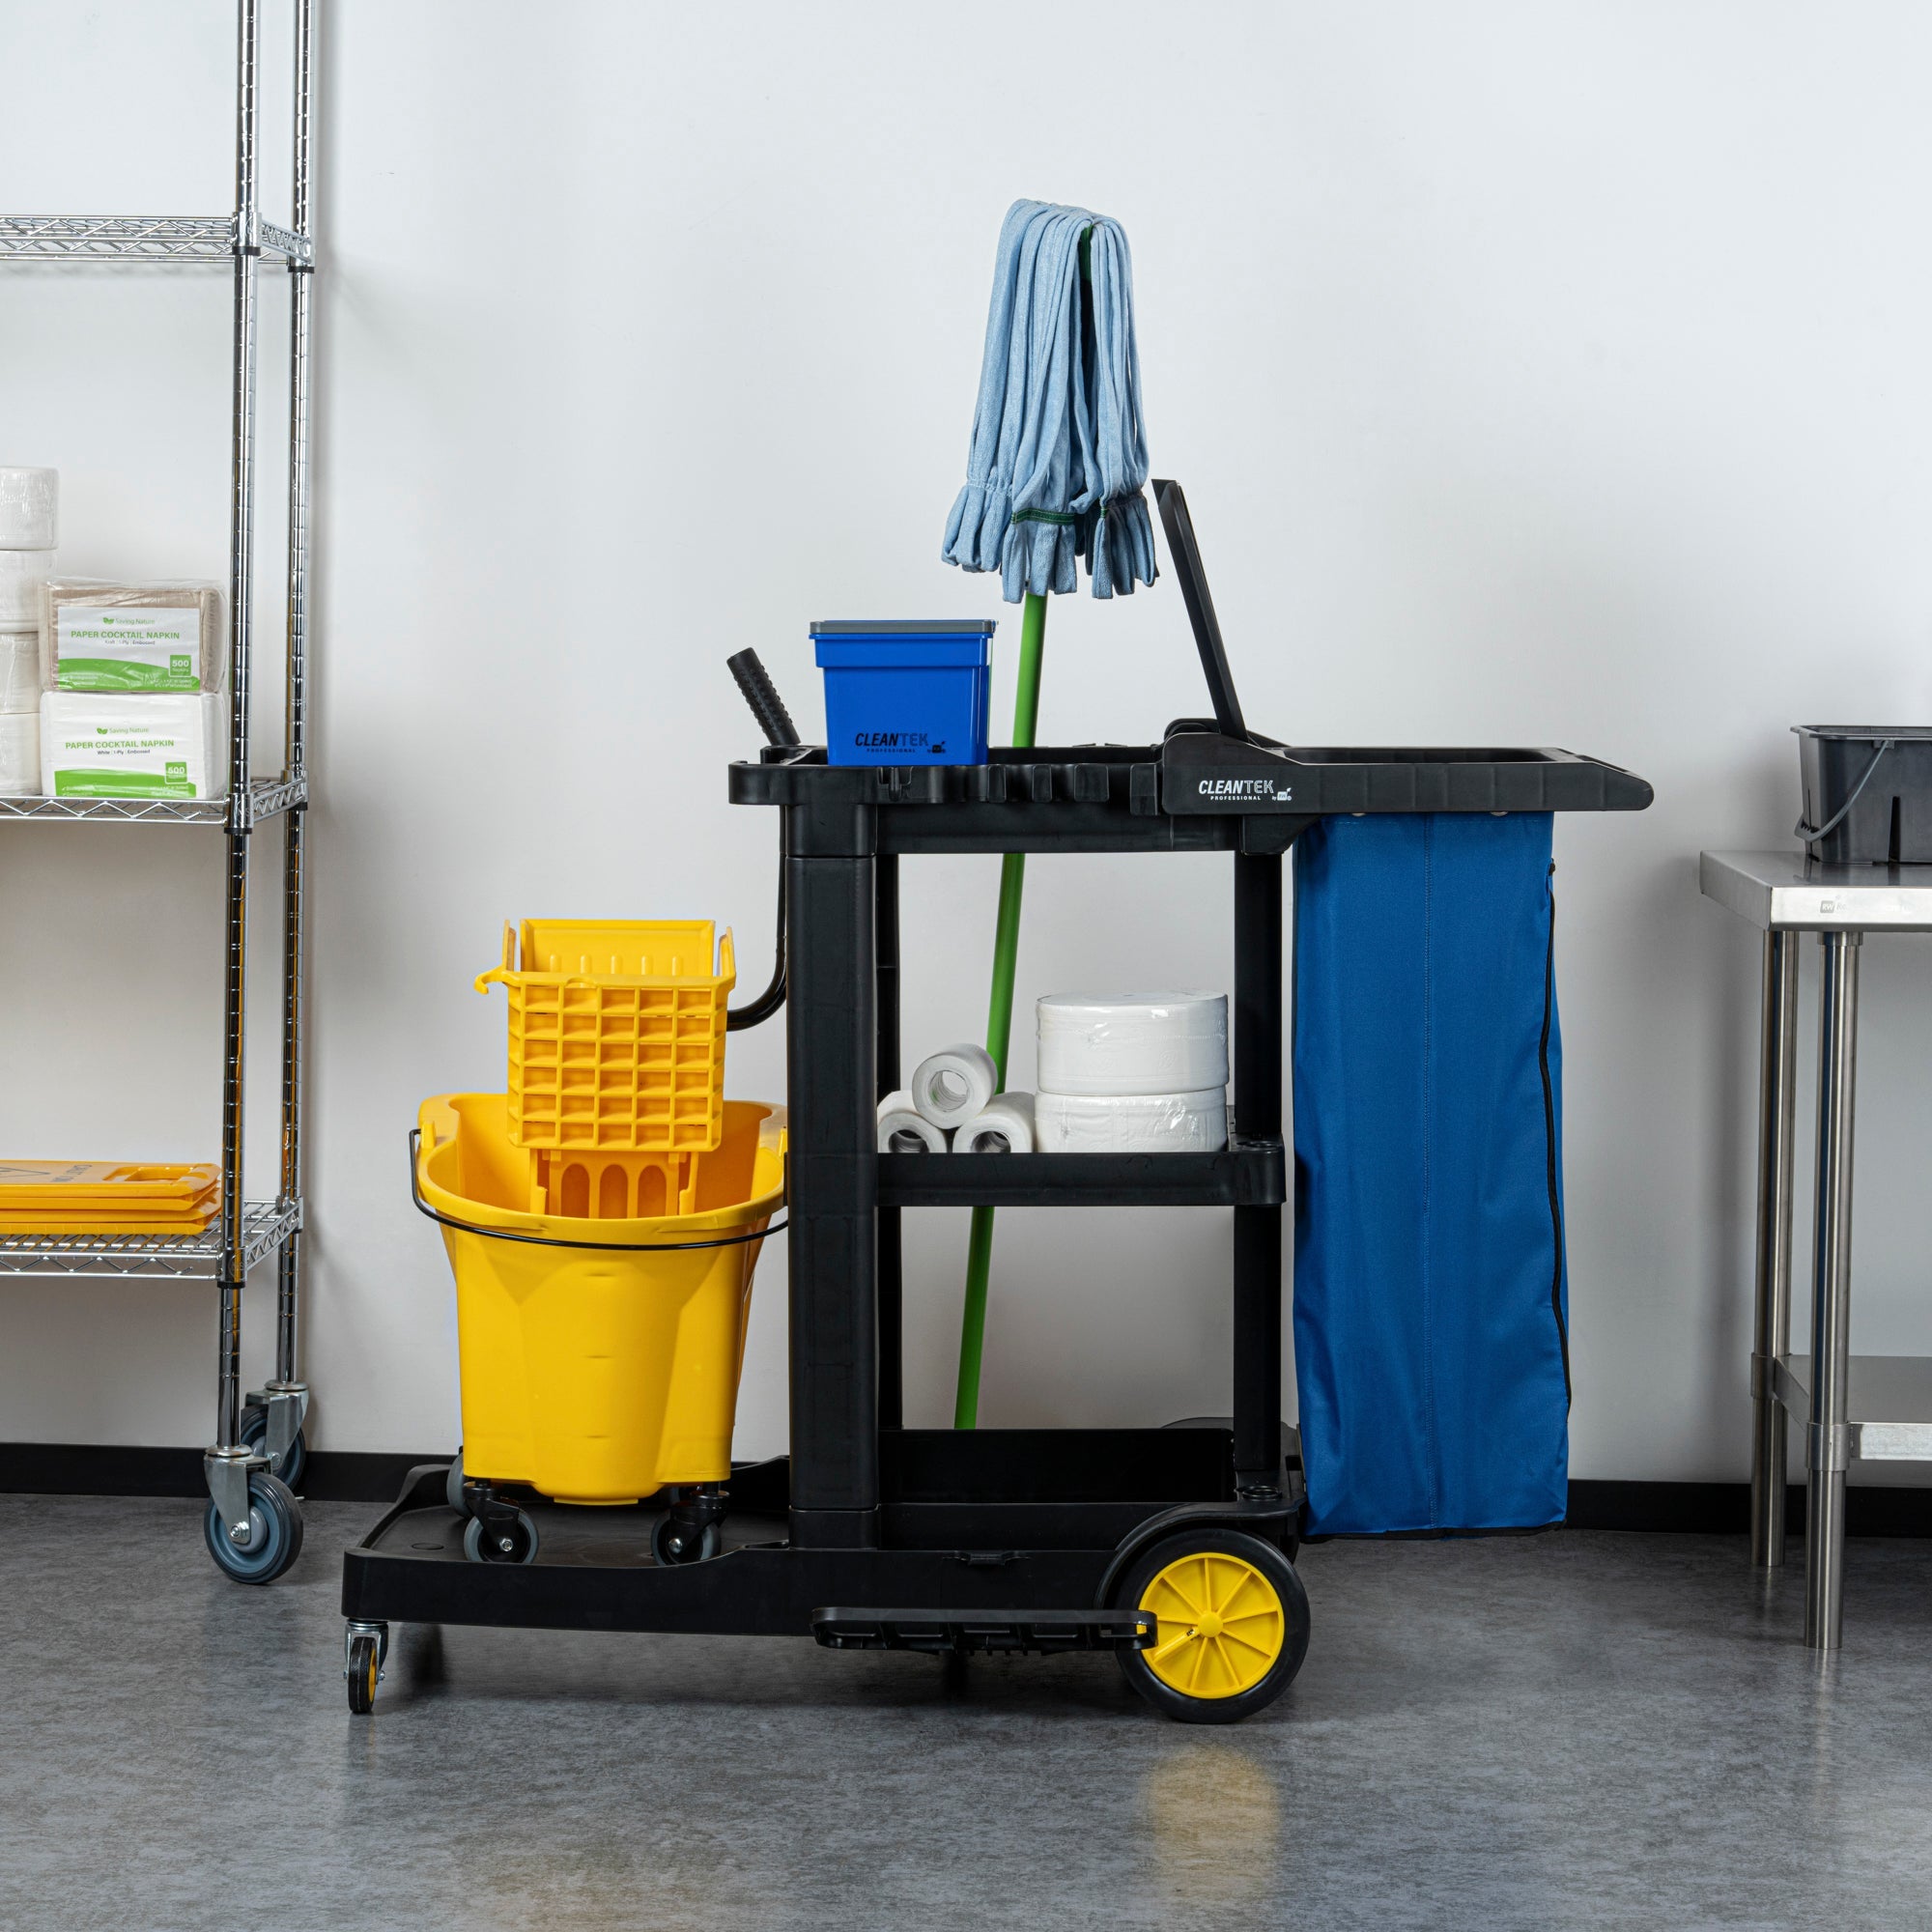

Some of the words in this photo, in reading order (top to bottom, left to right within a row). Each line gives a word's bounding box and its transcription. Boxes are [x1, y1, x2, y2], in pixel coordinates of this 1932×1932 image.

[71, 630, 99, 639] PAPER
[146, 631, 180, 639] NAPKIN
[65, 741, 94, 750] PAPER
[140, 739, 175, 748] NAPKIN
[855, 732, 928, 747] CLEANTEK
[1198, 780, 1274, 794] CLEANTEK
